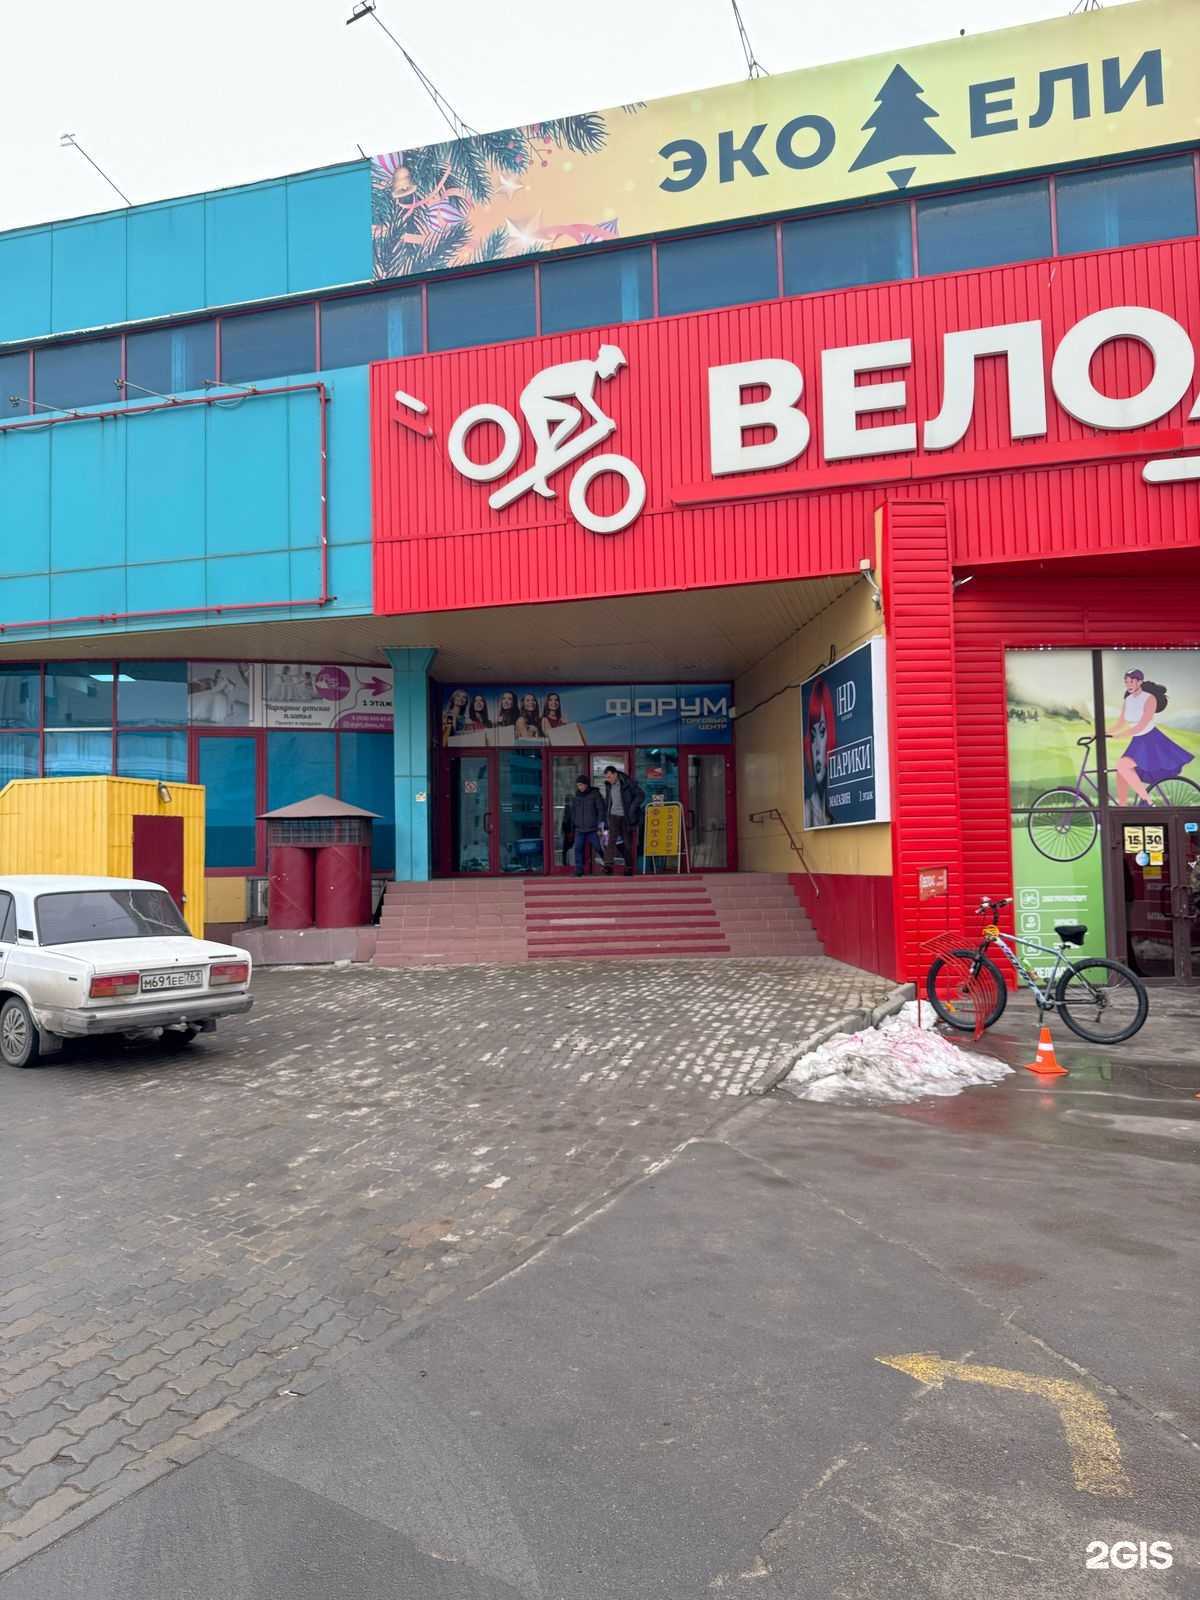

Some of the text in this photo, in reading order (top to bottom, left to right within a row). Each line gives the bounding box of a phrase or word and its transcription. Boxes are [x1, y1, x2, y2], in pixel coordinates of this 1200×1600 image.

[658, 48, 1165, 193] ЭКО ЕЛИ
[708, 306, 1200, 477] ВЕЛО
[606, 697, 727, 717] ФОРУМ
[829, 744, 871, 779] ПАРИКИ
